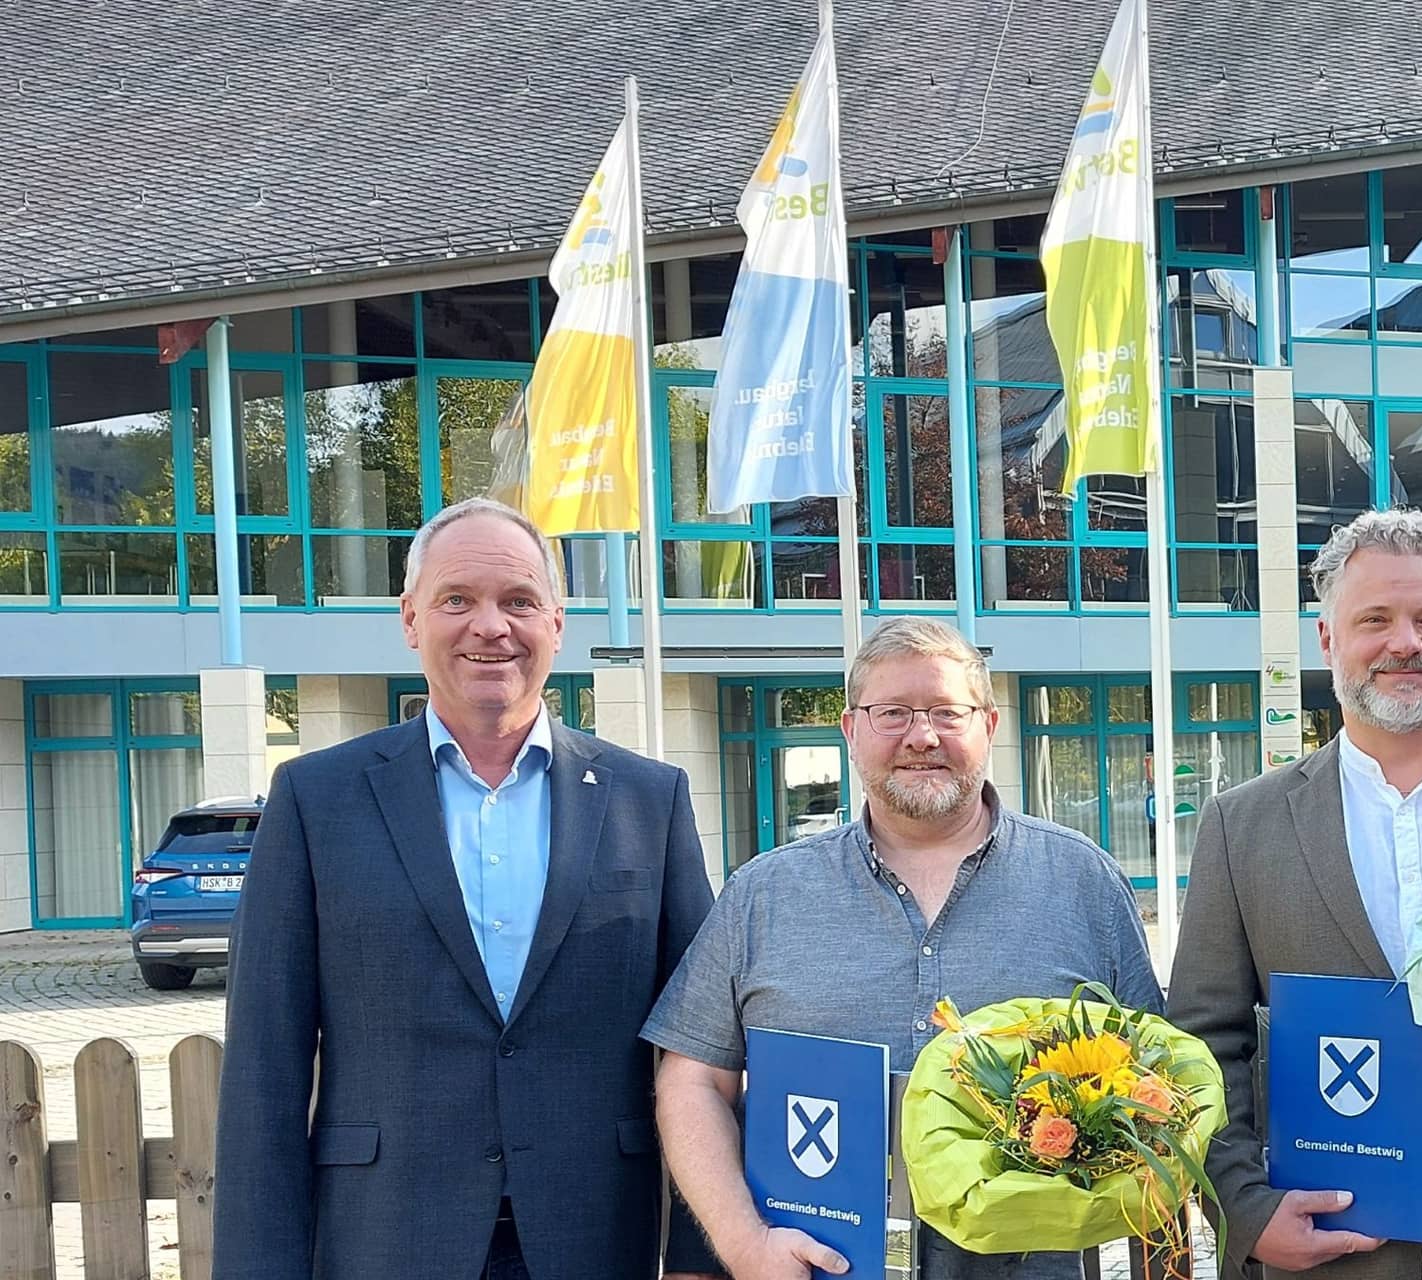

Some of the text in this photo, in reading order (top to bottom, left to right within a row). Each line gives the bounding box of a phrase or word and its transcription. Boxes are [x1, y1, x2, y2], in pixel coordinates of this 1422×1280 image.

[202, 877, 221, 888] HSK
[1295, 1138, 1404, 1161] Gemeinde Bestwig
[766, 1197, 861, 1225] Gemeinde Bestwig
